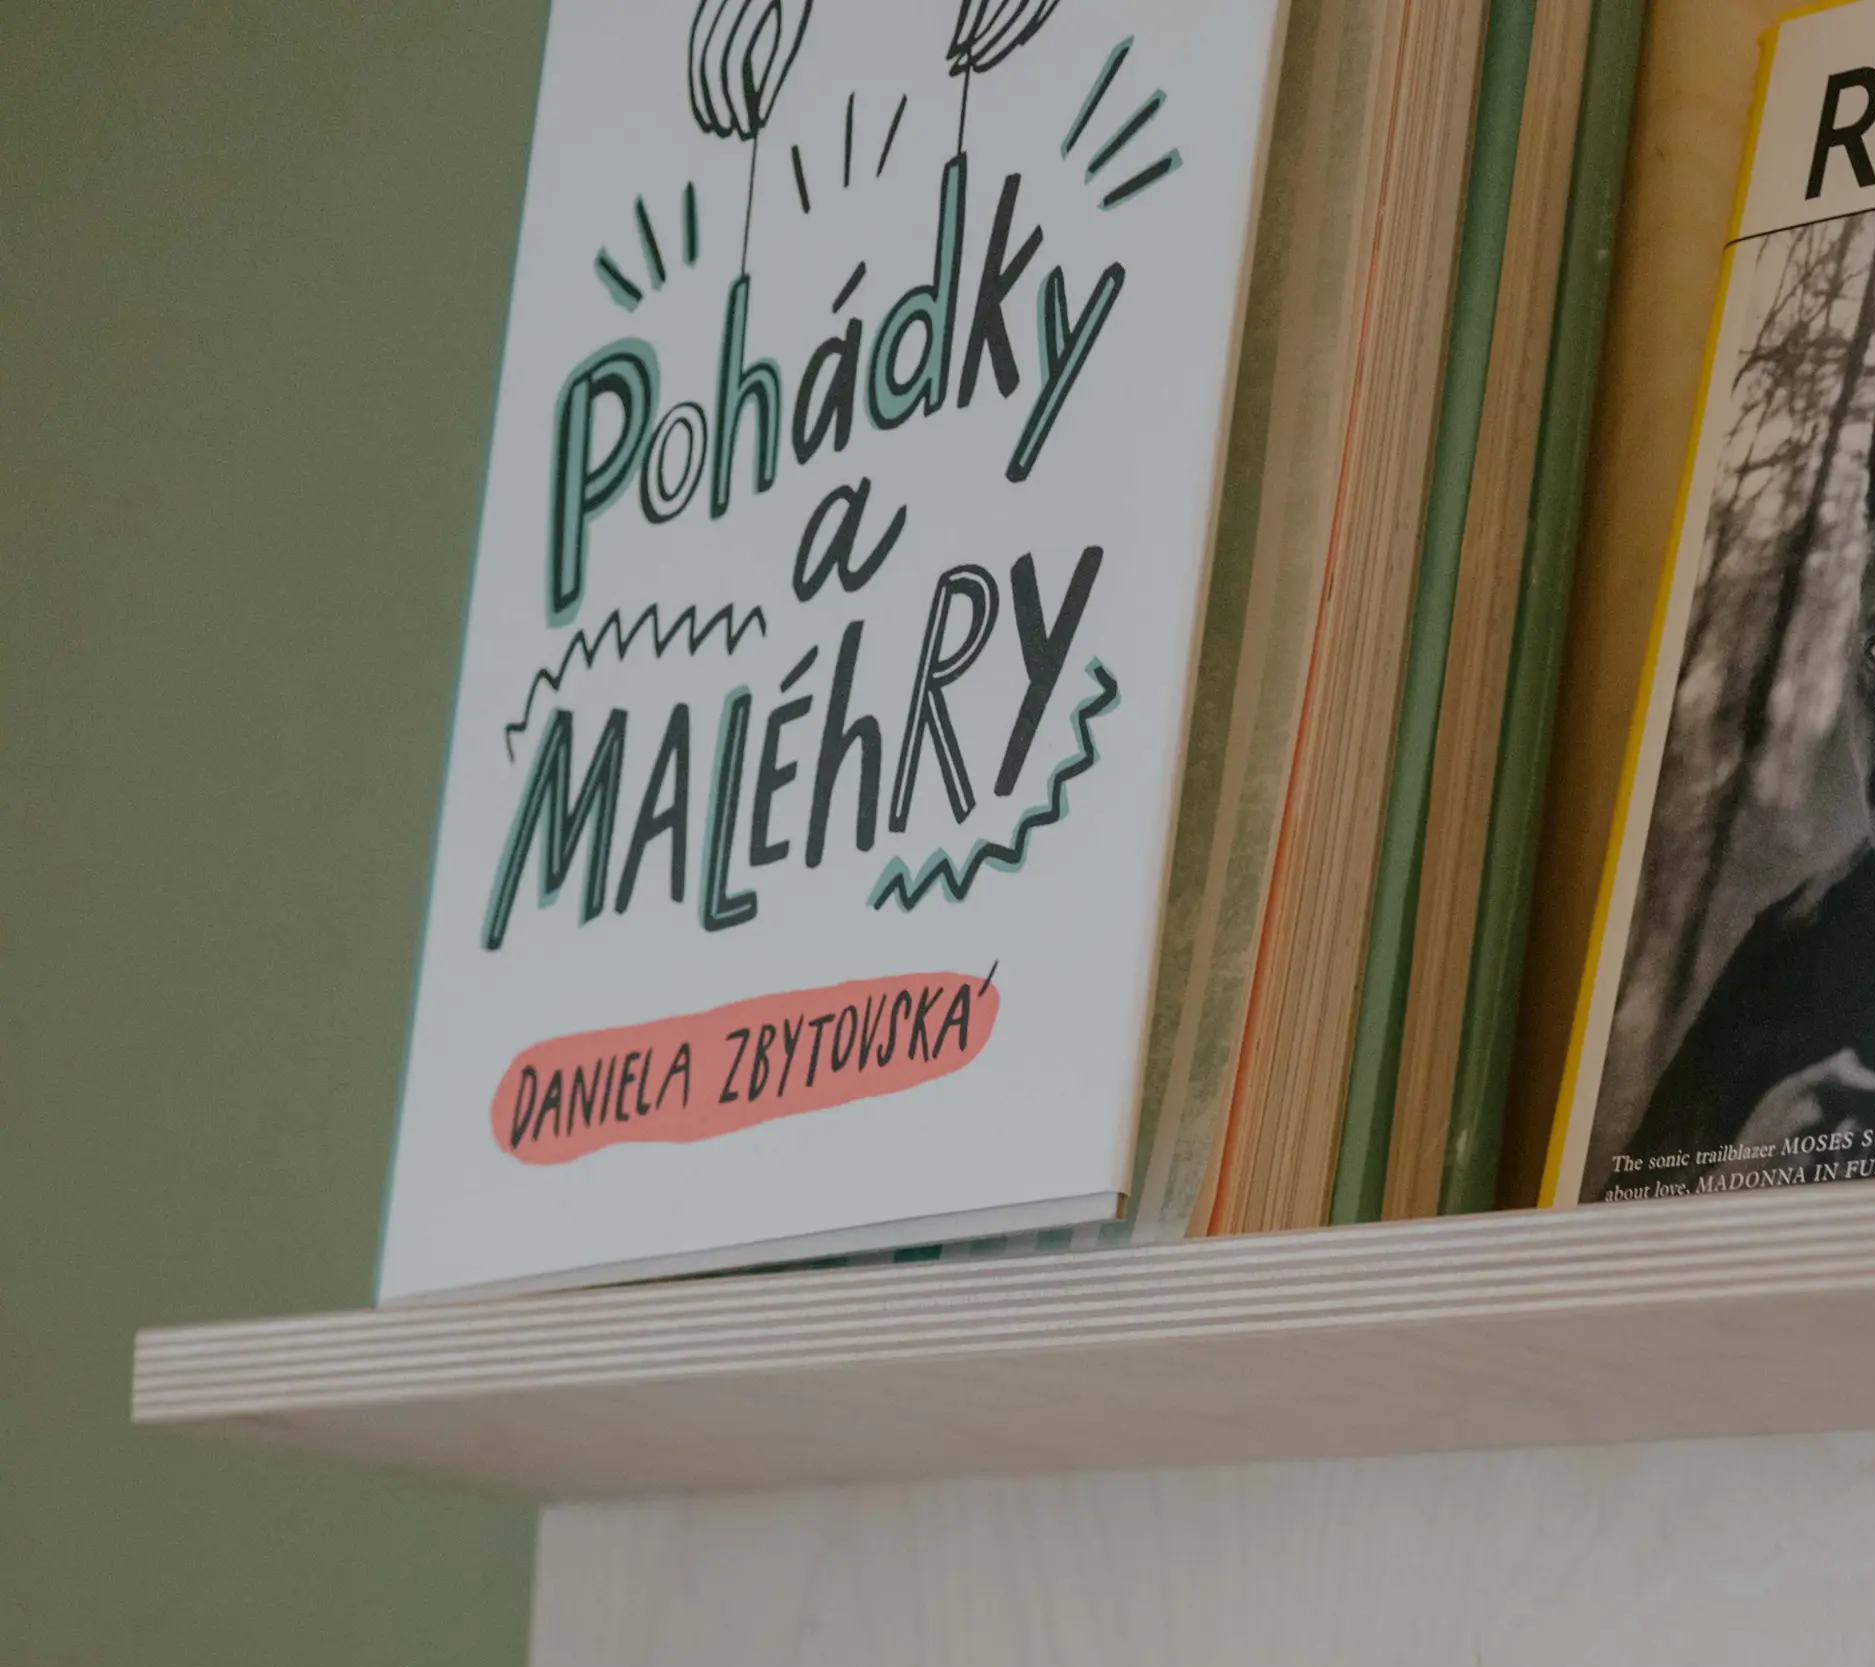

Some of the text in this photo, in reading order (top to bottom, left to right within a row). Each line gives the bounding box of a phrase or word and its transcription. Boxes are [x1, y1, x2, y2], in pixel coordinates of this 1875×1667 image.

[545, 151, 1126, 627] Pohádky
[793, 476, 907, 602] a
[507, 960, 1000, 1151] DANIELA ZBYTOVSKÁ
[1604, 1181, 1650, 1204] about
[1655, 1181, 1691, 1199] love,
[1695, 1165, 1806, 1194] MADONNA
[1814, 1162, 1838, 1183] IN
[1612, 1154, 1644, 1174] The
[1648, 1149, 1691, 1171] sonic
[1696, 1143, 1776, 1166] trailblazer
[1781, 1131, 1855, 1158] MOSES
